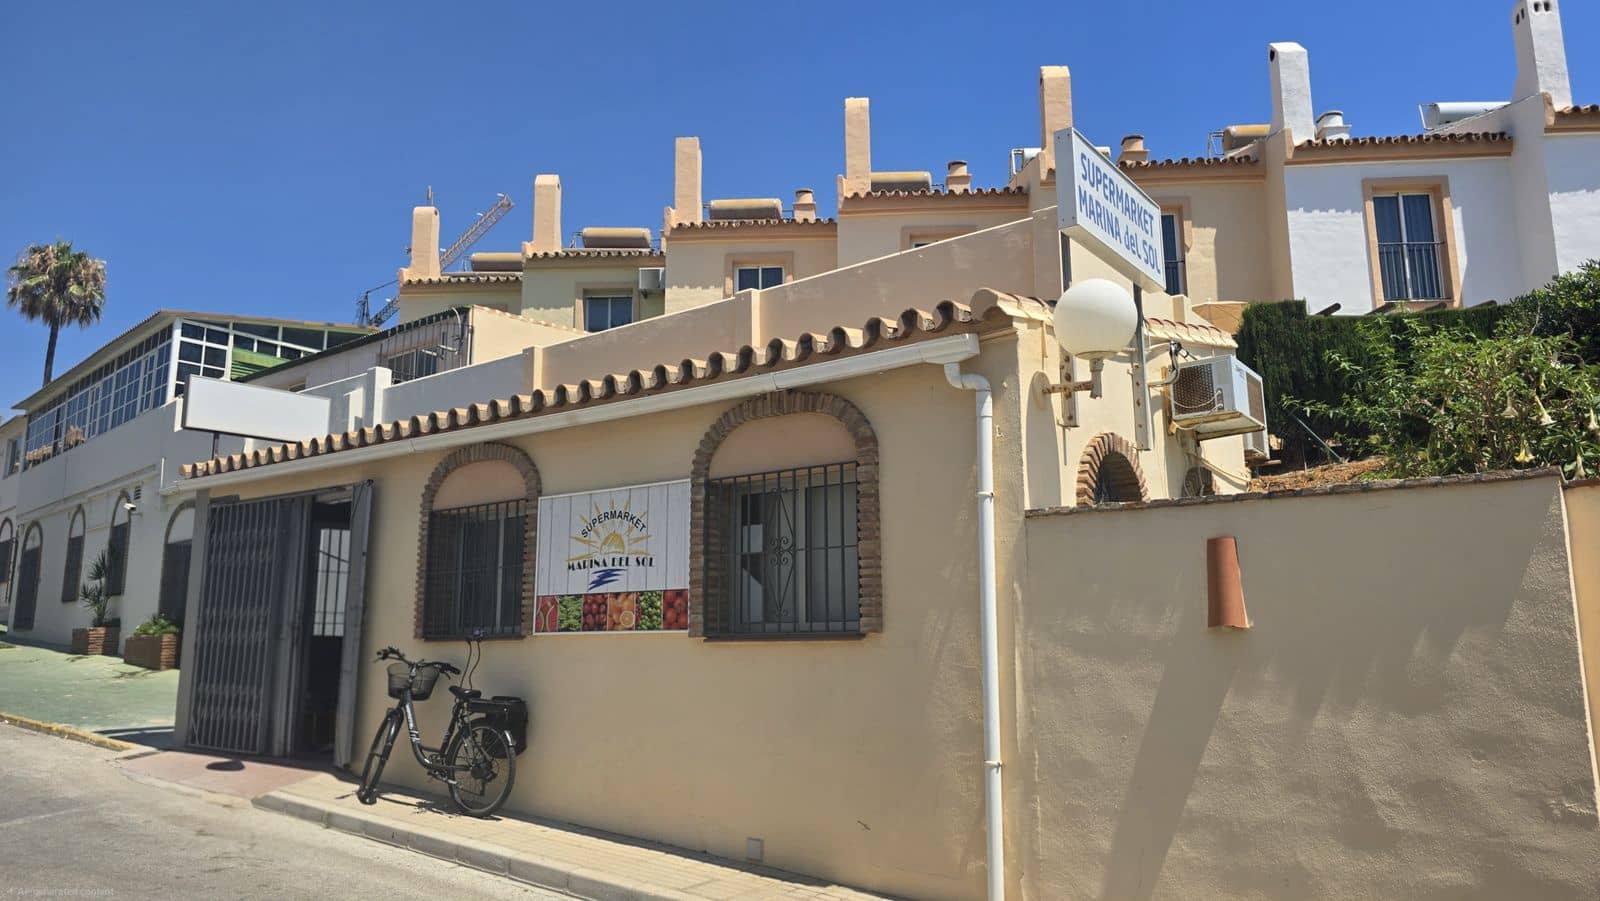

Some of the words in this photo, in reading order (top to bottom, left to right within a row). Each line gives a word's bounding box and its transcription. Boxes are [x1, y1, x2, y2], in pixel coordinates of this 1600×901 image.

[1080, 153, 1154, 238] SUPERMARKET
[1078, 184, 1122, 243] MARINA
[1143, 239, 1161, 275] SOL
[581, 510, 647, 538] SUPERMARKET
[568, 558, 607, 571] MARINA
[611, 557, 630, 568] DEL
[636, 556, 655, 567] SOL
